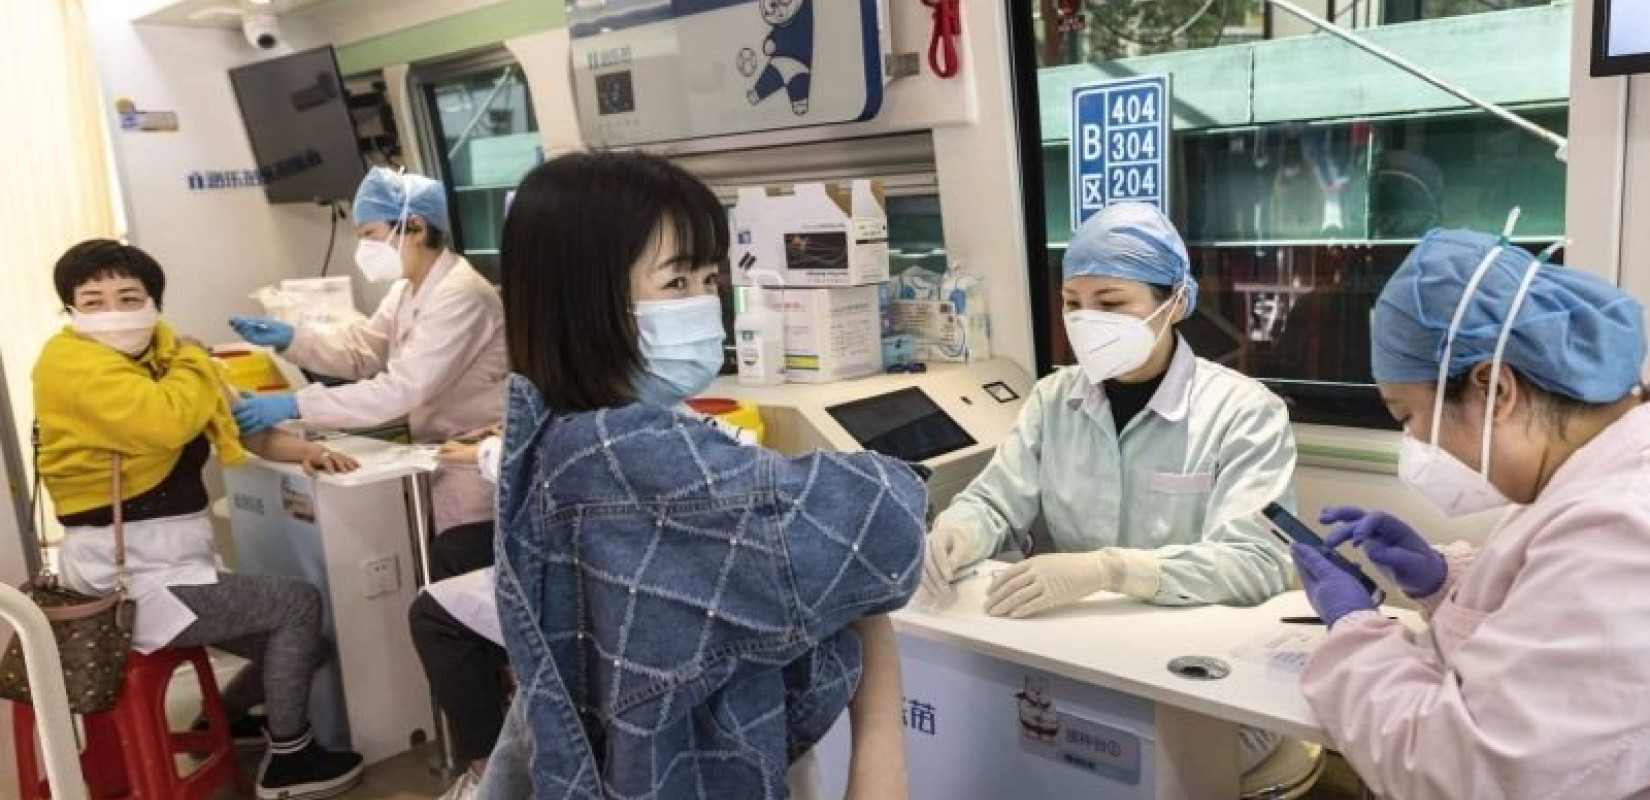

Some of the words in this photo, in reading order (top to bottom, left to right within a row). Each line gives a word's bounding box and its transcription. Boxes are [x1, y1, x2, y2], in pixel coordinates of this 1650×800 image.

[1111, 93, 1156, 123] 404
[1112, 130, 1156, 160] 304
[1113, 167, 1156, 197] 204
